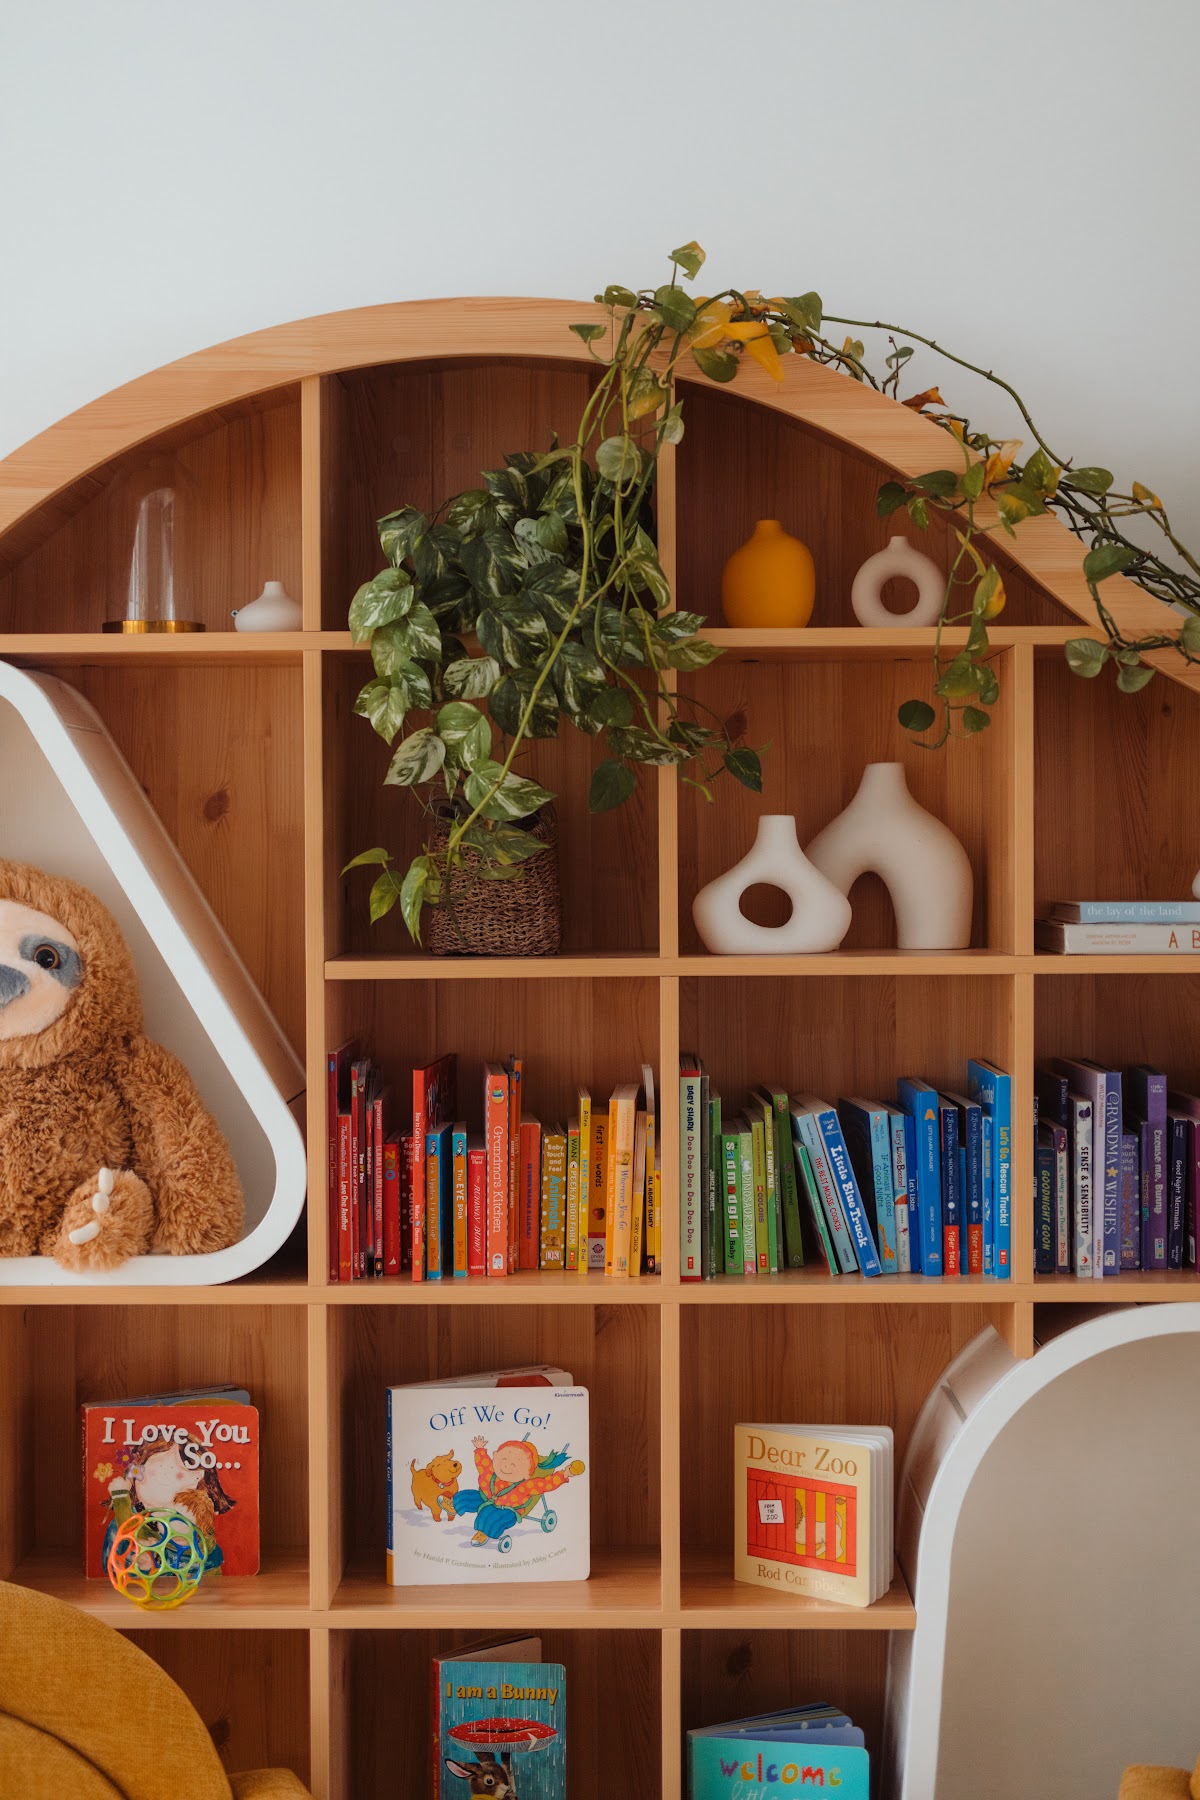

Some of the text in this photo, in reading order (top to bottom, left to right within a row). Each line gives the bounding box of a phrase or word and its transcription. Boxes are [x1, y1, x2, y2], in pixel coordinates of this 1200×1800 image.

[1088, 905, 1182, 918] the lay of the land
[1168, 930, 1178, 948] A
[596, 1125, 604, 1144] first
[946, 1117, 954, 1132] LOVE
[946, 1134, 954, 1146] YOU
[385, 1151, 395, 1180] ZOO
[894, 1130, 906, 1188] Larry Loves Boston!
[1104, 1092, 1119, 1235] GRANDMA WISHES
[1154, 1130, 1164, 1214] Excuse me, Bunny
[492, 1126, 504, 1233] Grandma's Kitchen
[874, 1165, 884, 1208] Good Night
[882, 1163, 893, 1217] Animals Kissed
[999, 1127, 1009, 1226] Let's Go, Rescue Trucks!
[1174, 1176, 1182, 1193] Night
[430, 1202, 436, 1212] Up
[456, 1184, 464, 1201] EYE
[549, 1176, 561, 1230] Animals
[618, 1170, 629, 1230] Wherever You Go
[726, 1142, 739, 1259] sad mad glad Baby
[814, 1158, 842, 1232] THE BEST MOUSE COOKIE
[830, 1145, 868, 1248] Little Blue Truck
[1042, 1170, 1050, 1223] GOODNIGHT
[430, 1214, 436, 1223] On
[473, 1184, 481, 1254] RUNAWAY BUNNY
[742, 1174, 753, 1258] DINOSAUR DANCE!
[948, 1231, 956, 1249] tiger
[1042, 1224, 1050, 1250] GOON
[948, 1251, 956, 1268] tales
[102, 1417, 251, 1447] I Love You
[430, 1405, 552, 1431] Off We Go!
[184, 1443, 241, 1470] So...
[386, 1451, 391, 1463] We
[747, 1435, 857, 1476] Dear Zoo
[414, 1550, 422, 1558] by
[423, 1552, 444, 1564] Harold
[451, 1560, 486, 1569] Gershenson
[493, 1561, 521, 1569] illustrated
[522, 1559, 530, 1568] by
[532, 1554, 547, 1565] Abby
[548, 1546, 567, 1559] Carter
[757, 1564, 780, 1581] Rod
[446, 1682, 558, 1705] I am a Bunny
[720, 1753, 842, 1786] welcome
